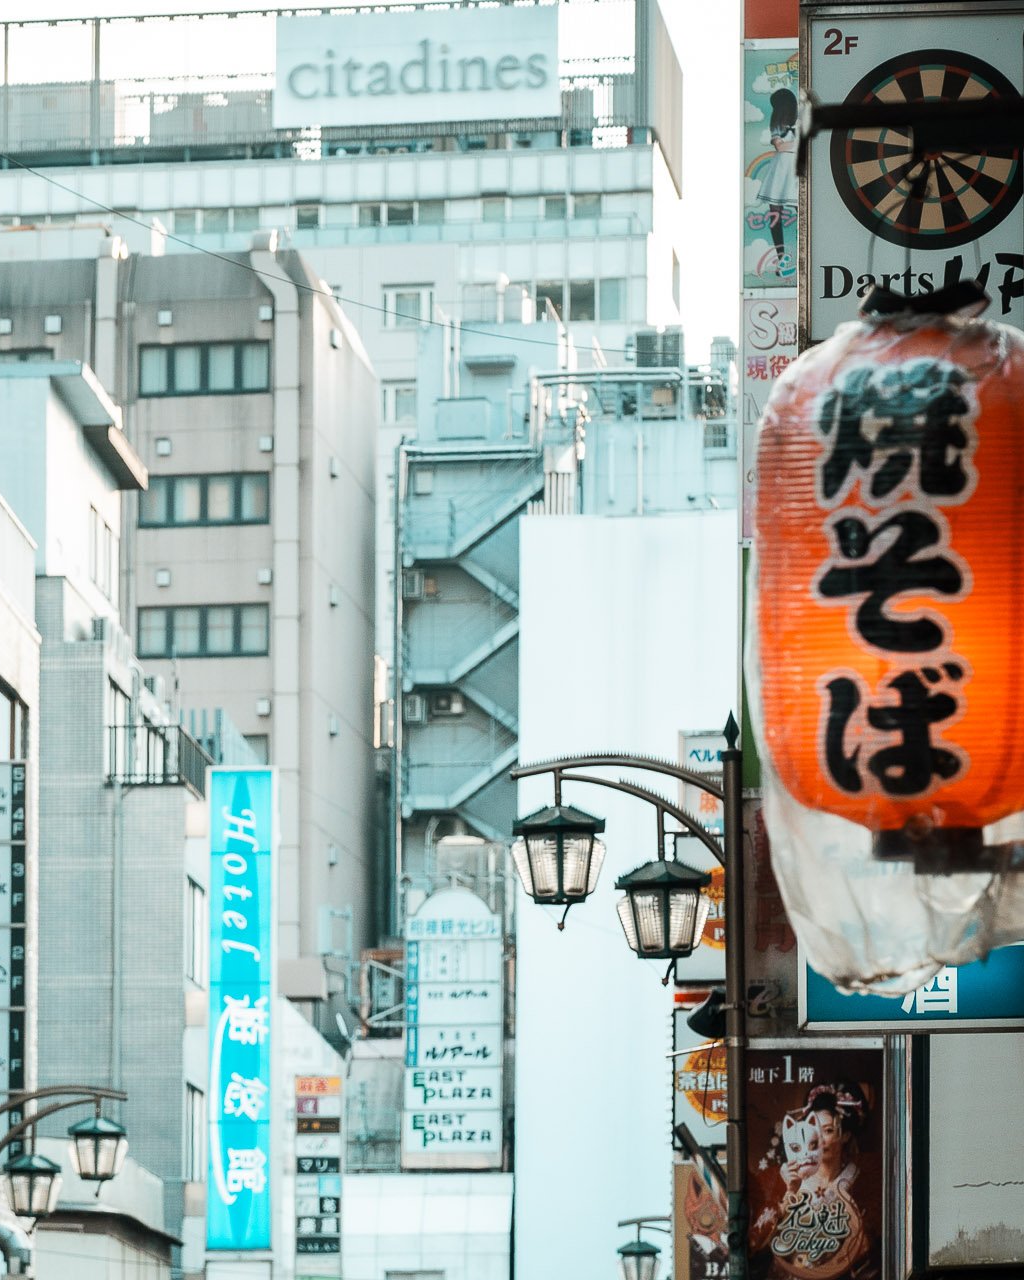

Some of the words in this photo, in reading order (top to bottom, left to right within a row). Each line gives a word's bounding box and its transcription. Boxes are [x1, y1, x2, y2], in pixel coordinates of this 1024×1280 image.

[823, 28, 858, 56] 2F
[287, 37, 549, 101] citadines
[819, 265, 934, 300] Darts
[747, 355, 799, 381] 現役
[817, 364, 970, 796] 焼そば
[689, 749, 722, 762] ベル
[222, 806, 261, 962] Hotel
[426, 1045, 492, 1061] ルノアール
[413, 1071, 467, 1088] EAST
[749, 1055, 815, 1084] 地下1階
[424, 1086, 493, 1104] PLAZA
[413, 1114, 467, 1130] EAST
[423, 1128, 493, 1147] PLAZA
[774, 1231, 839, 1259] Tokyo
